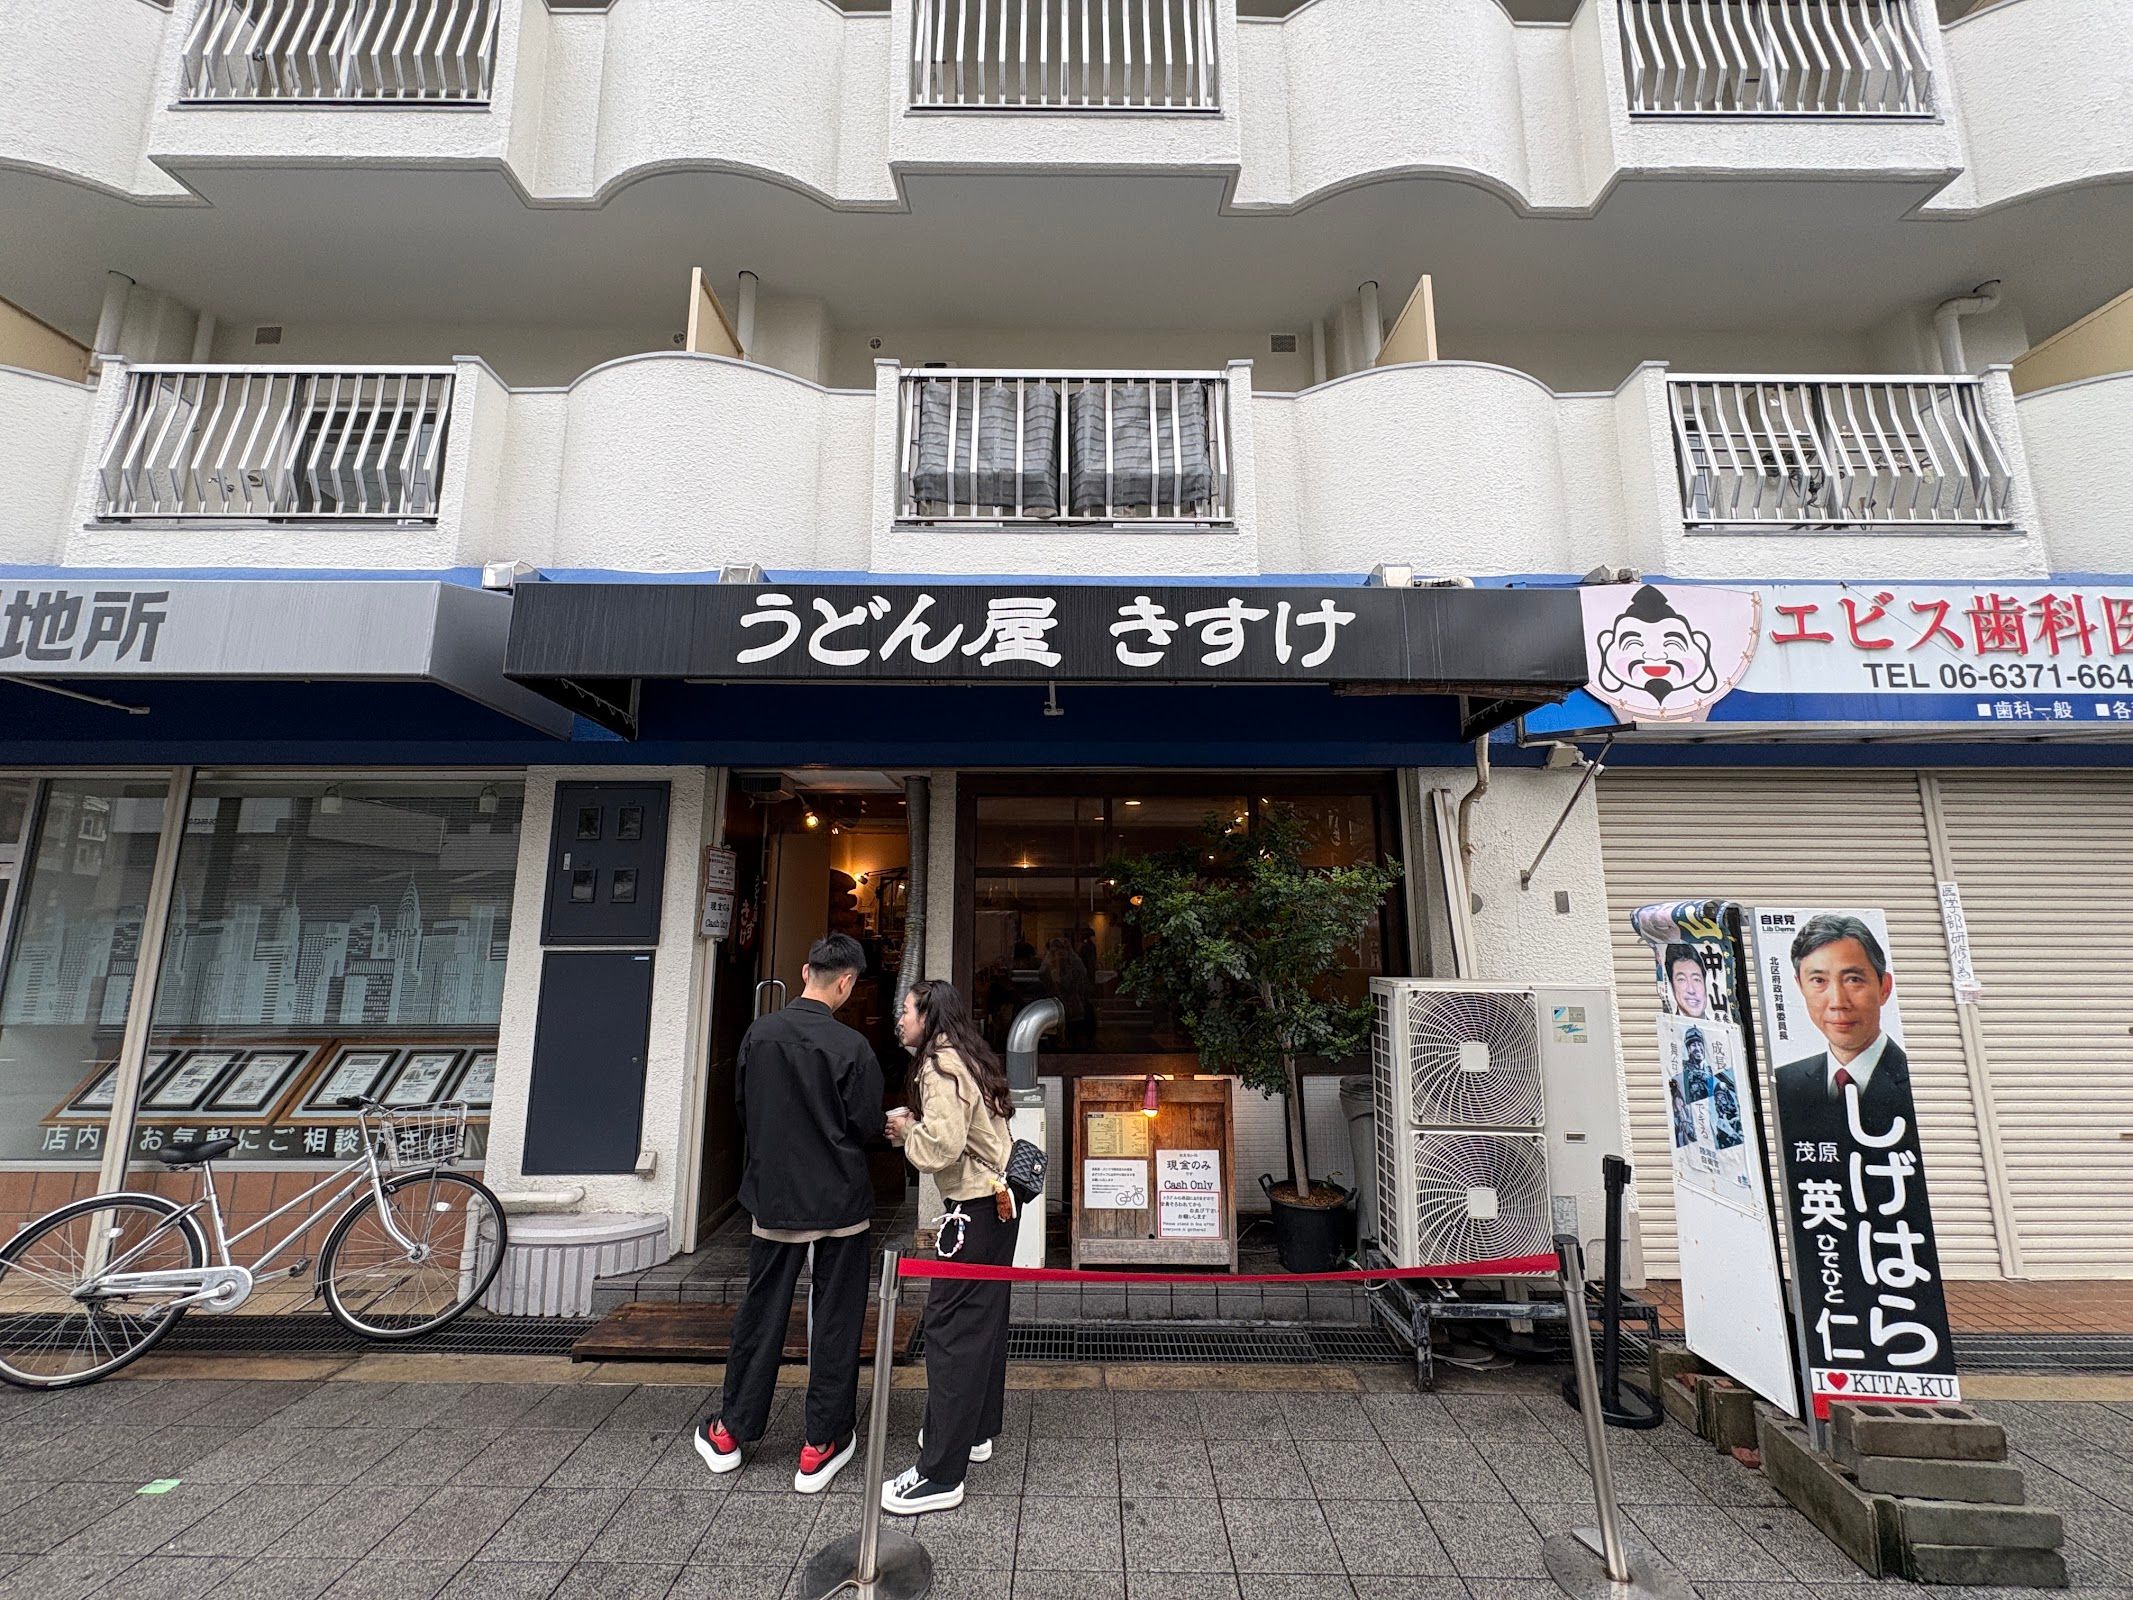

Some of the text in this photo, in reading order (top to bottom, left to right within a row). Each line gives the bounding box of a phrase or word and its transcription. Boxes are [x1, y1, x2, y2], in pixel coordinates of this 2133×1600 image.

[737, 593, 1356, 668] うどん屋 きすけ
[1863, 663, 1930, 688] TEL
[1993, 700, 2073, 719] 歯科一般
[1760, 914, 1796, 925] 自民党
[1700, 944, 1728, 1013] 中山
[1769, 956, 1789, 1041] 北区府政対策委員長
[1711, 1041, 1727, 1071] 成長
[42, 1125, 101, 1151] 店内
[1794, 1141, 1840, 1163] 茂原
[1166, 1160, 1211, 1171] 現金のみ
[1164, 1180, 1213, 1190] Cash Only
[1800, 1179, 1848, 1231] 英
[1846, 1084, 1938, 1366] しげはら
[1816, 1234, 1845, 1304] ひでひと
[1815, 1308, 1865, 1362] 仁
[1816, 1371, 1955, 1398] I KITA-KU
